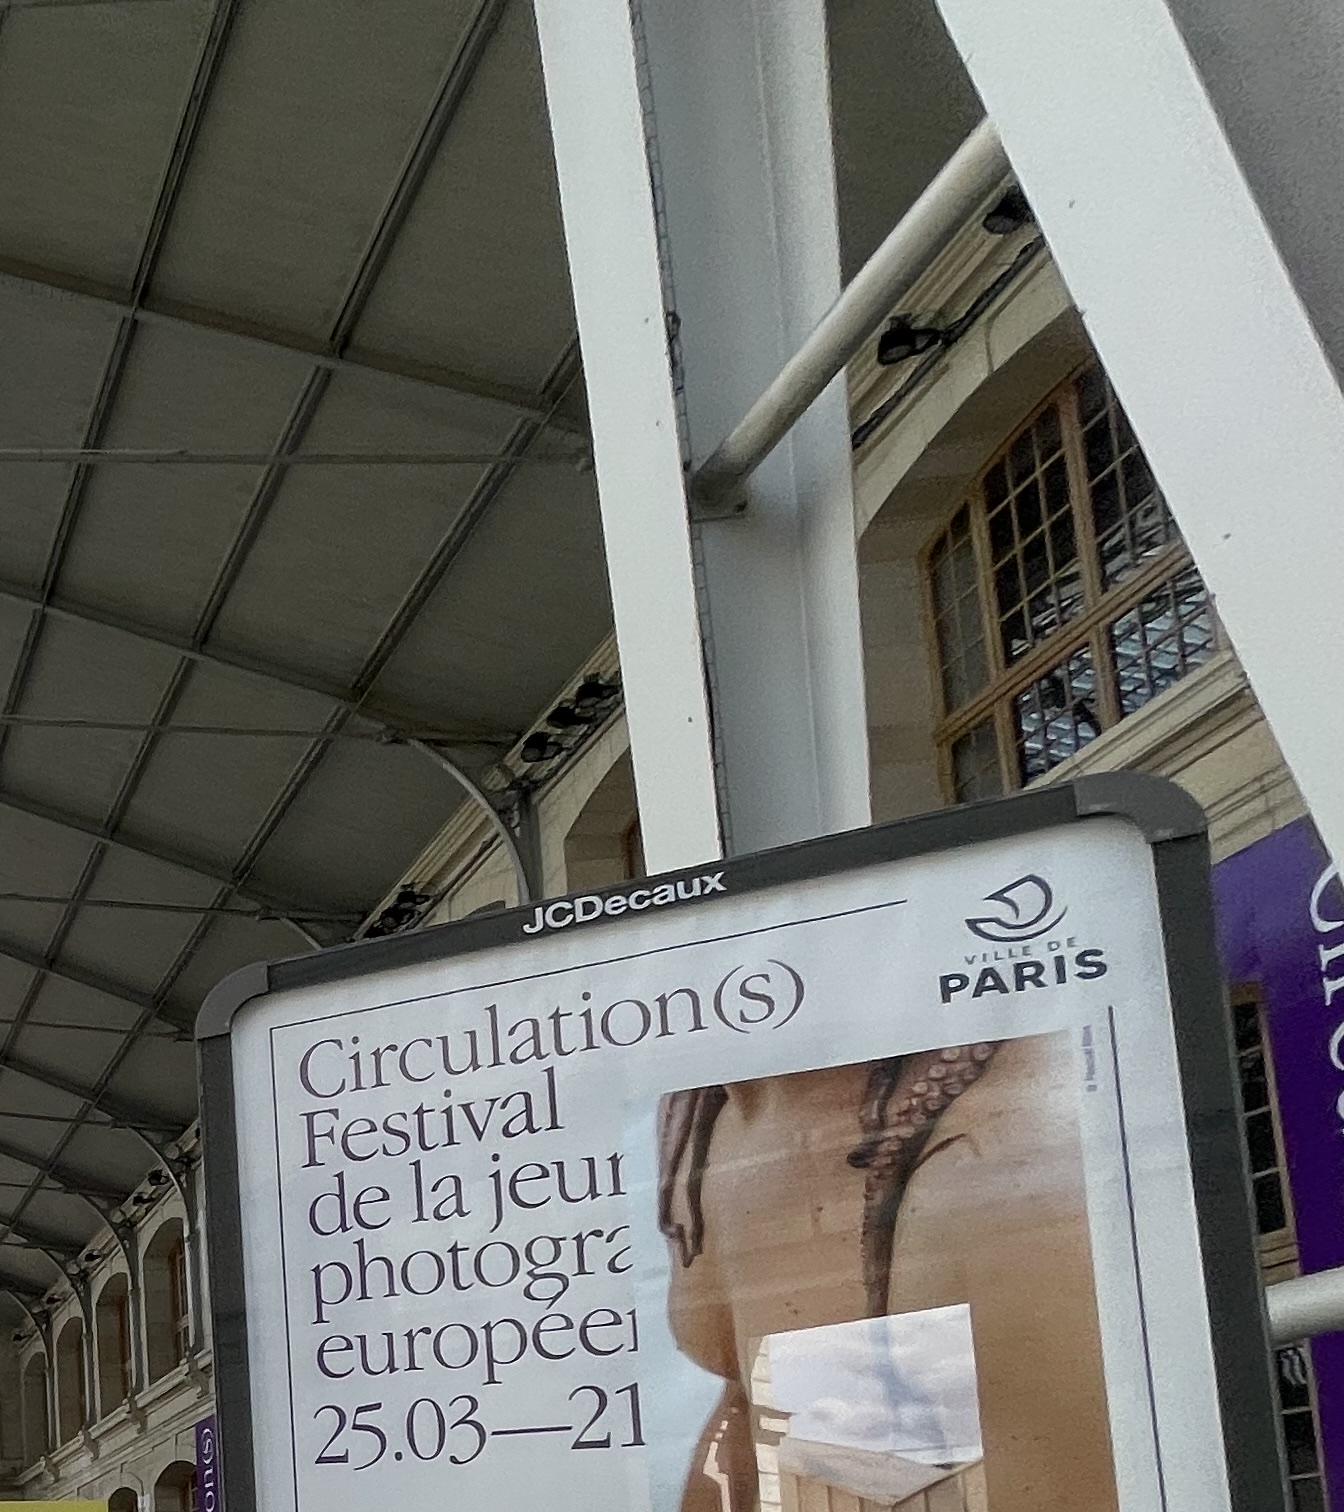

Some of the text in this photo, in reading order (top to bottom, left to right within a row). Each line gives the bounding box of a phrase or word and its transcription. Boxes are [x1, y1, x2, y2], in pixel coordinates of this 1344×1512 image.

[522, 871, 728, 935] JCDecaux
[938, 948, 1108, 1005] PARIS
[964, 936, 1080, 966] VILLE DE
[298, 958, 806, 1100] Circulation(s)
[299, 1066, 566, 1169] Festival
[308, 1171, 392, 1237] de
[410, 1159, 472, 1224] la
